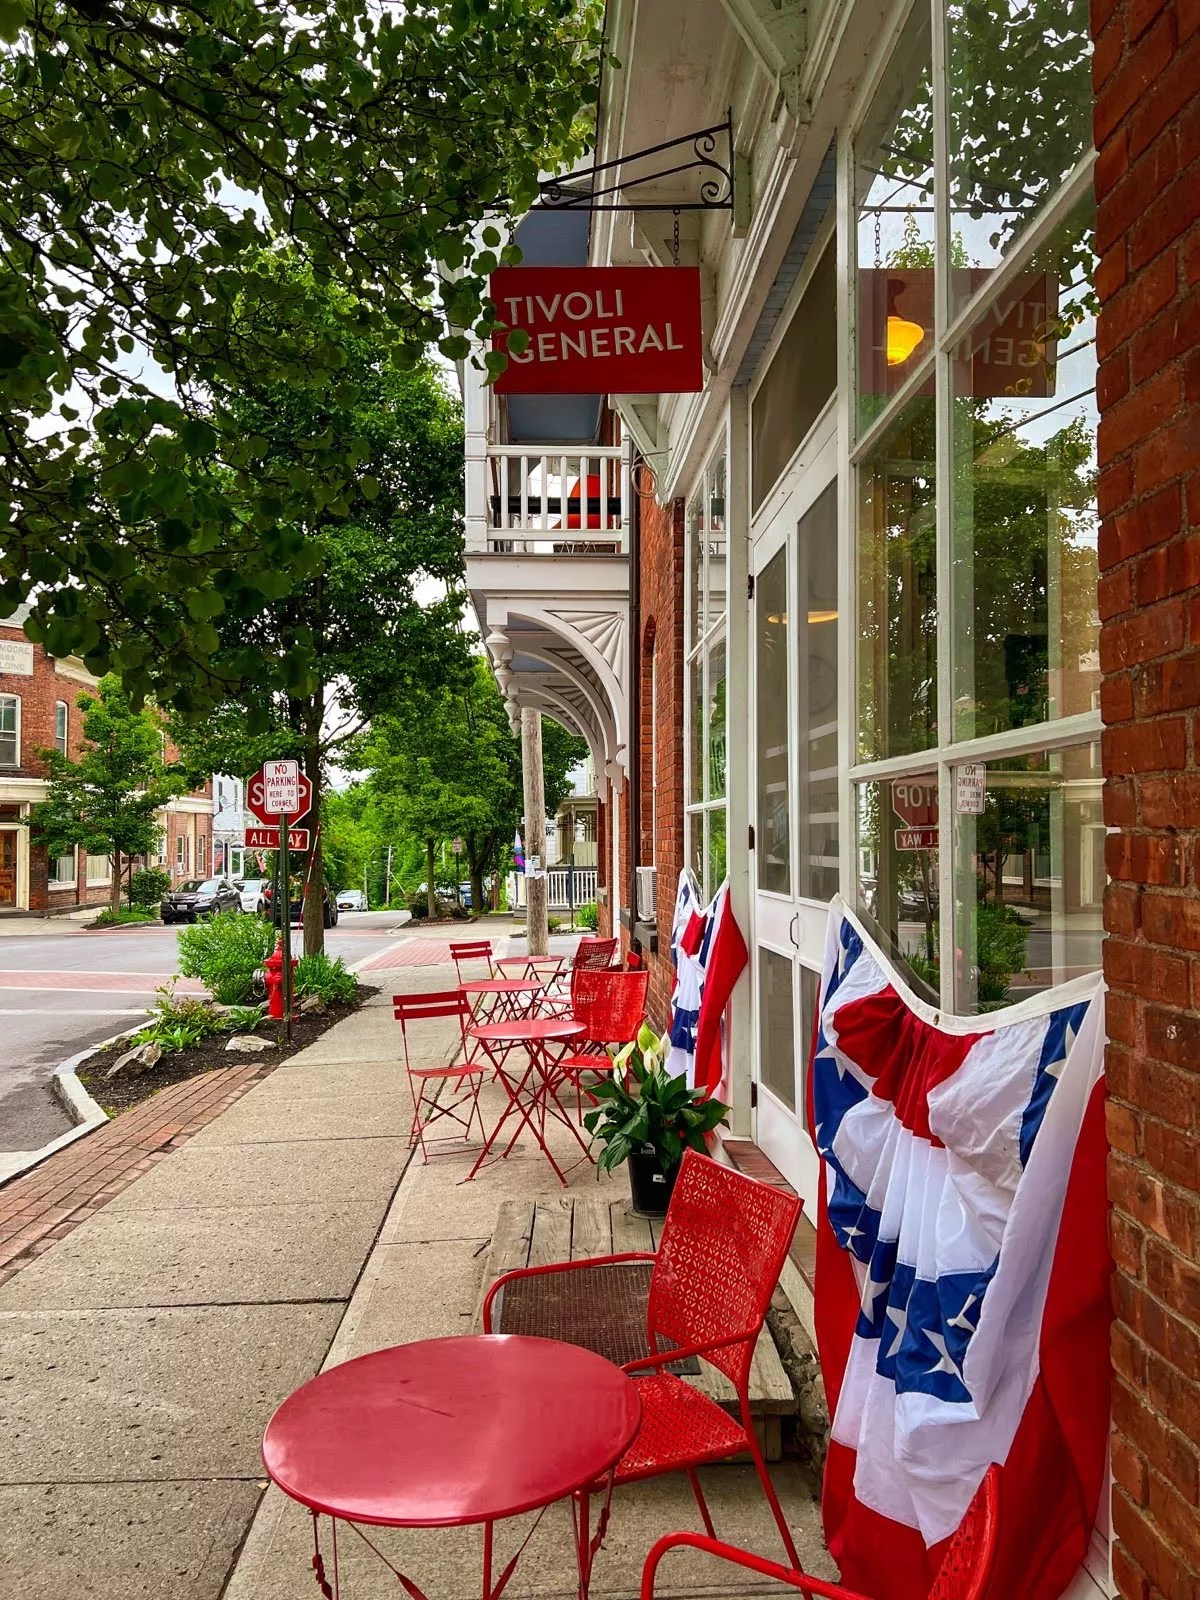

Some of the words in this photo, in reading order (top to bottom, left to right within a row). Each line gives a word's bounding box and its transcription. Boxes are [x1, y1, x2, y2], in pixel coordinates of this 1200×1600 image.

[504, 289, 623, 325] TIVOLI
[274, 764, 288, 775] NO
[267, 776, 296, 787] PARKING
[269, 790, 283, 798] HERE
[271, 799, 293, 808] CORNER
[250, 831, 274, 845] ALL
[278, 833, 302, 846] AY
